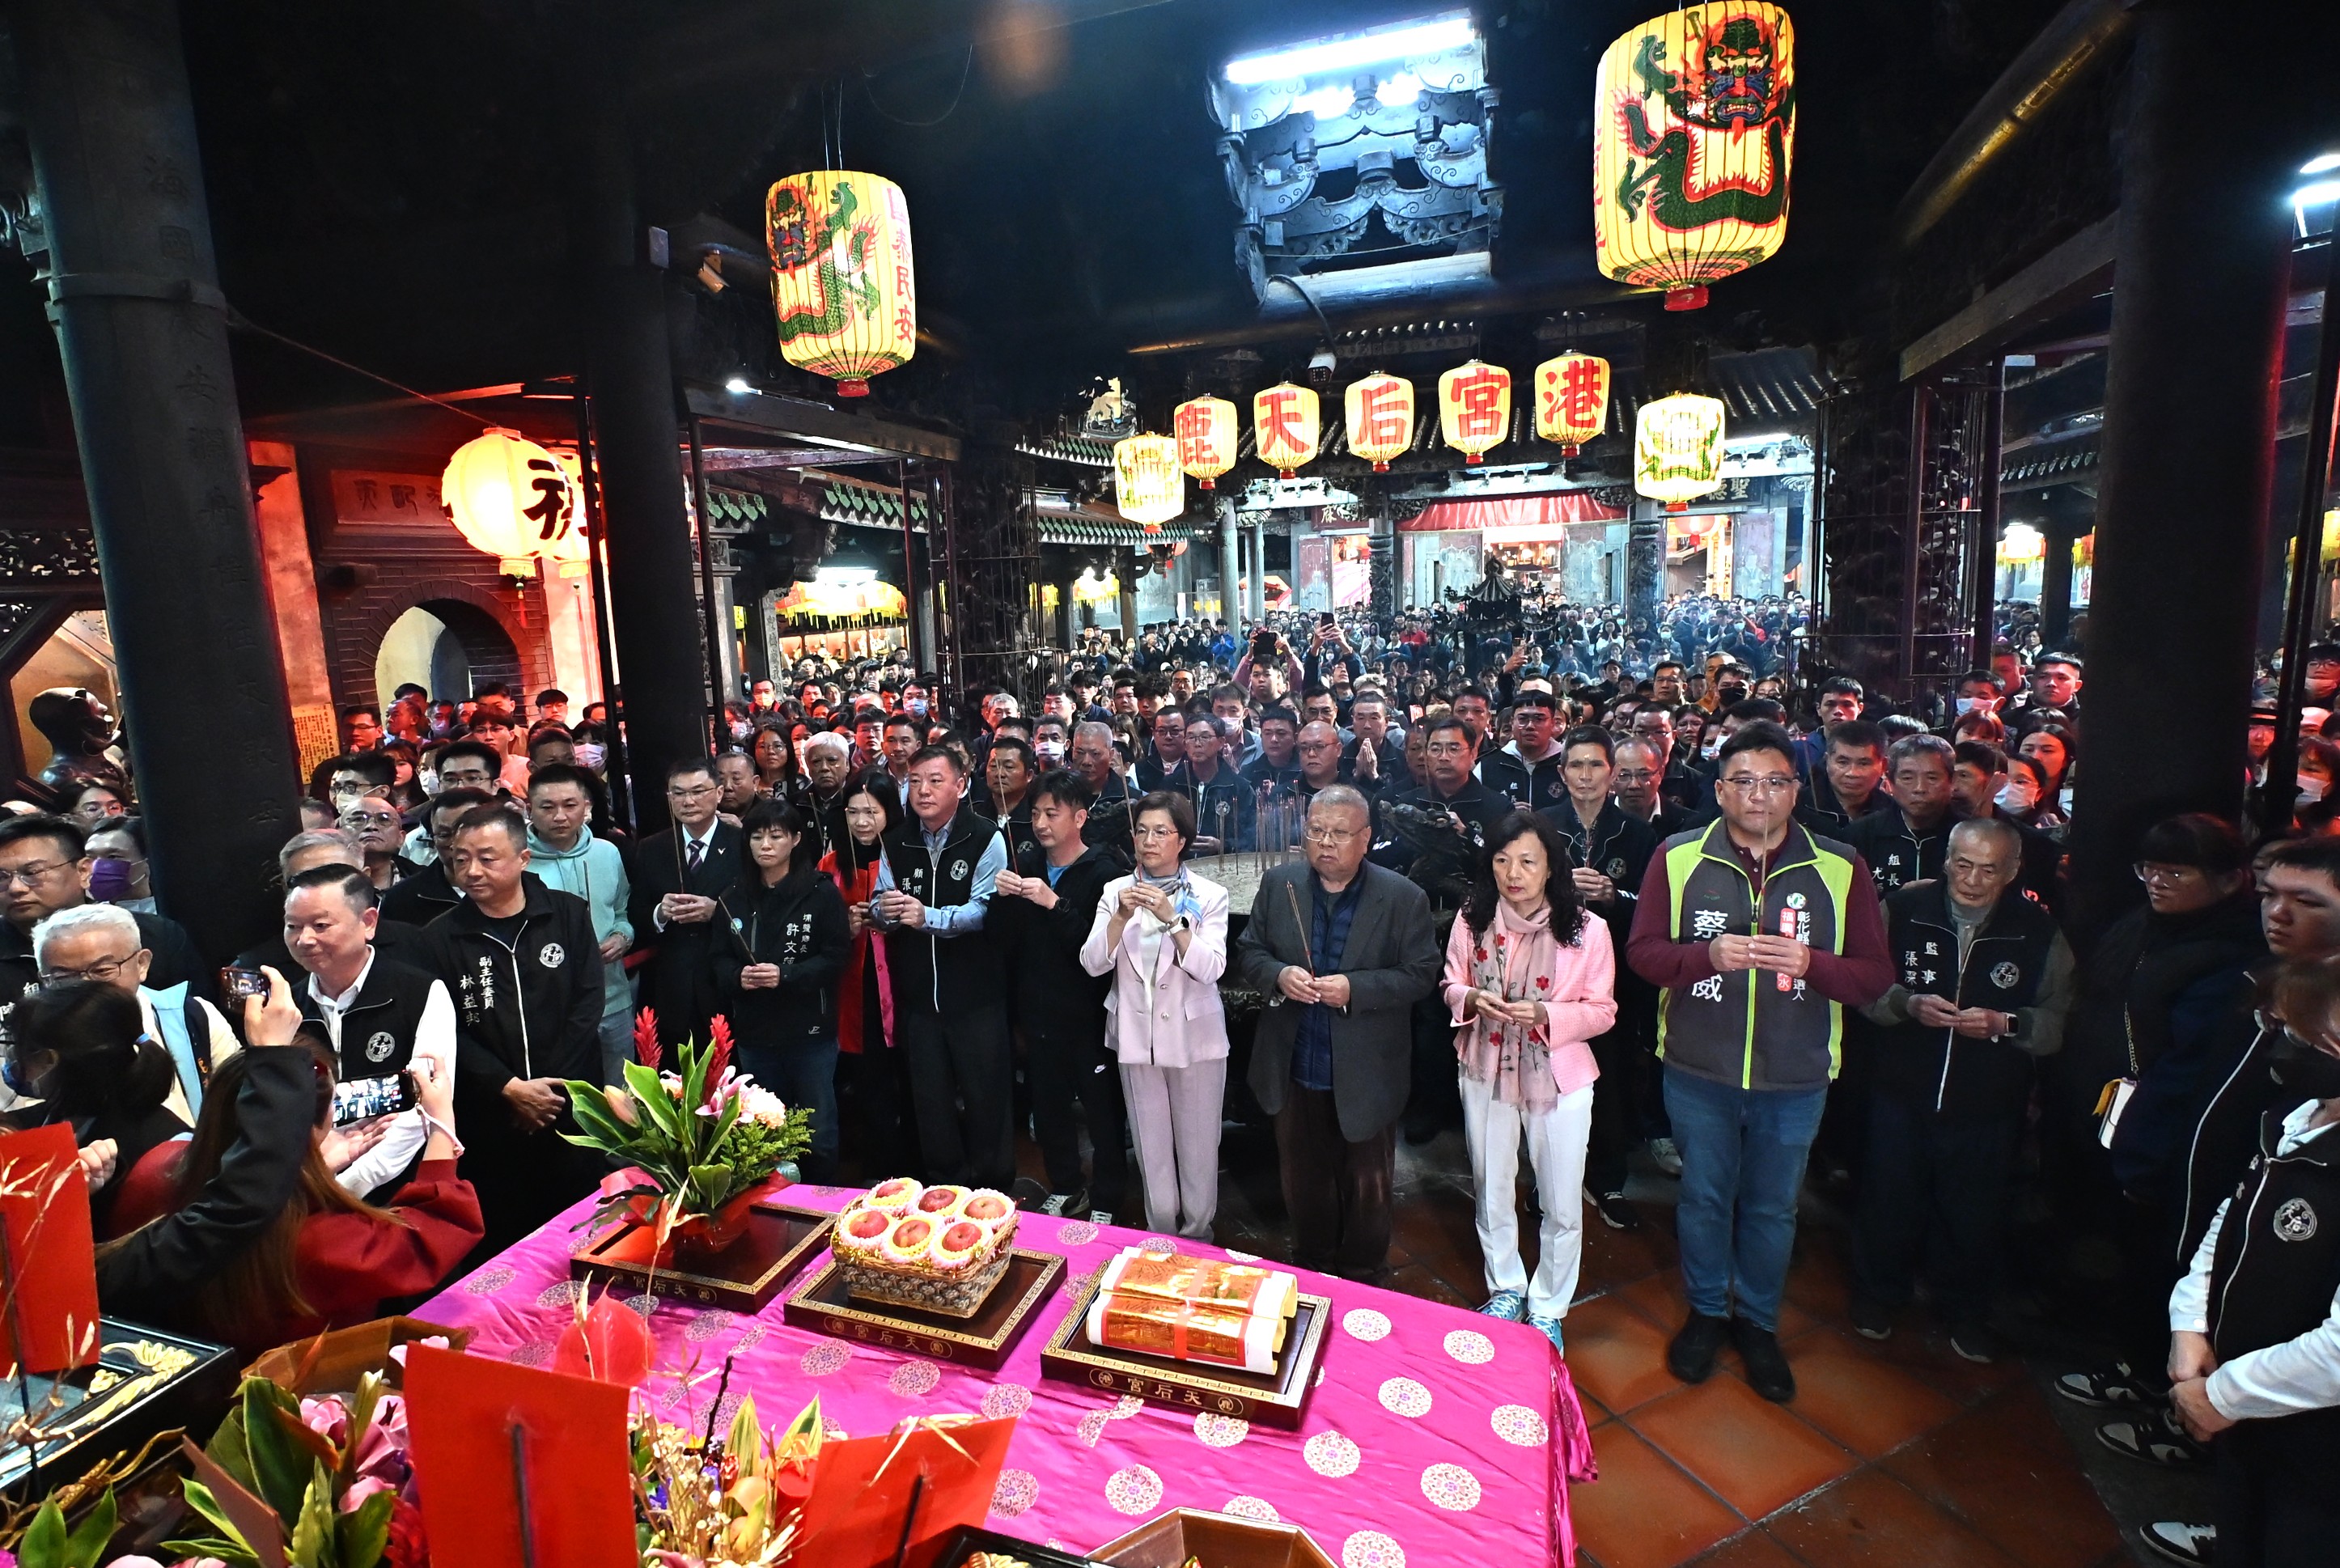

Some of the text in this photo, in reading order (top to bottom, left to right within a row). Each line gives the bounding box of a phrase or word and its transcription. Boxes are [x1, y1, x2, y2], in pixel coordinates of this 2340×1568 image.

[1175, 359, 1603, 466] 鹿 天 后 宮 港
[1887, 854, 1901, 887] 組長
[1691, 909, 1728, 1002] 蔡威
[1922, 942, 1939, 985] 監事
[479, 956, 495, 1009] 副主任委員
